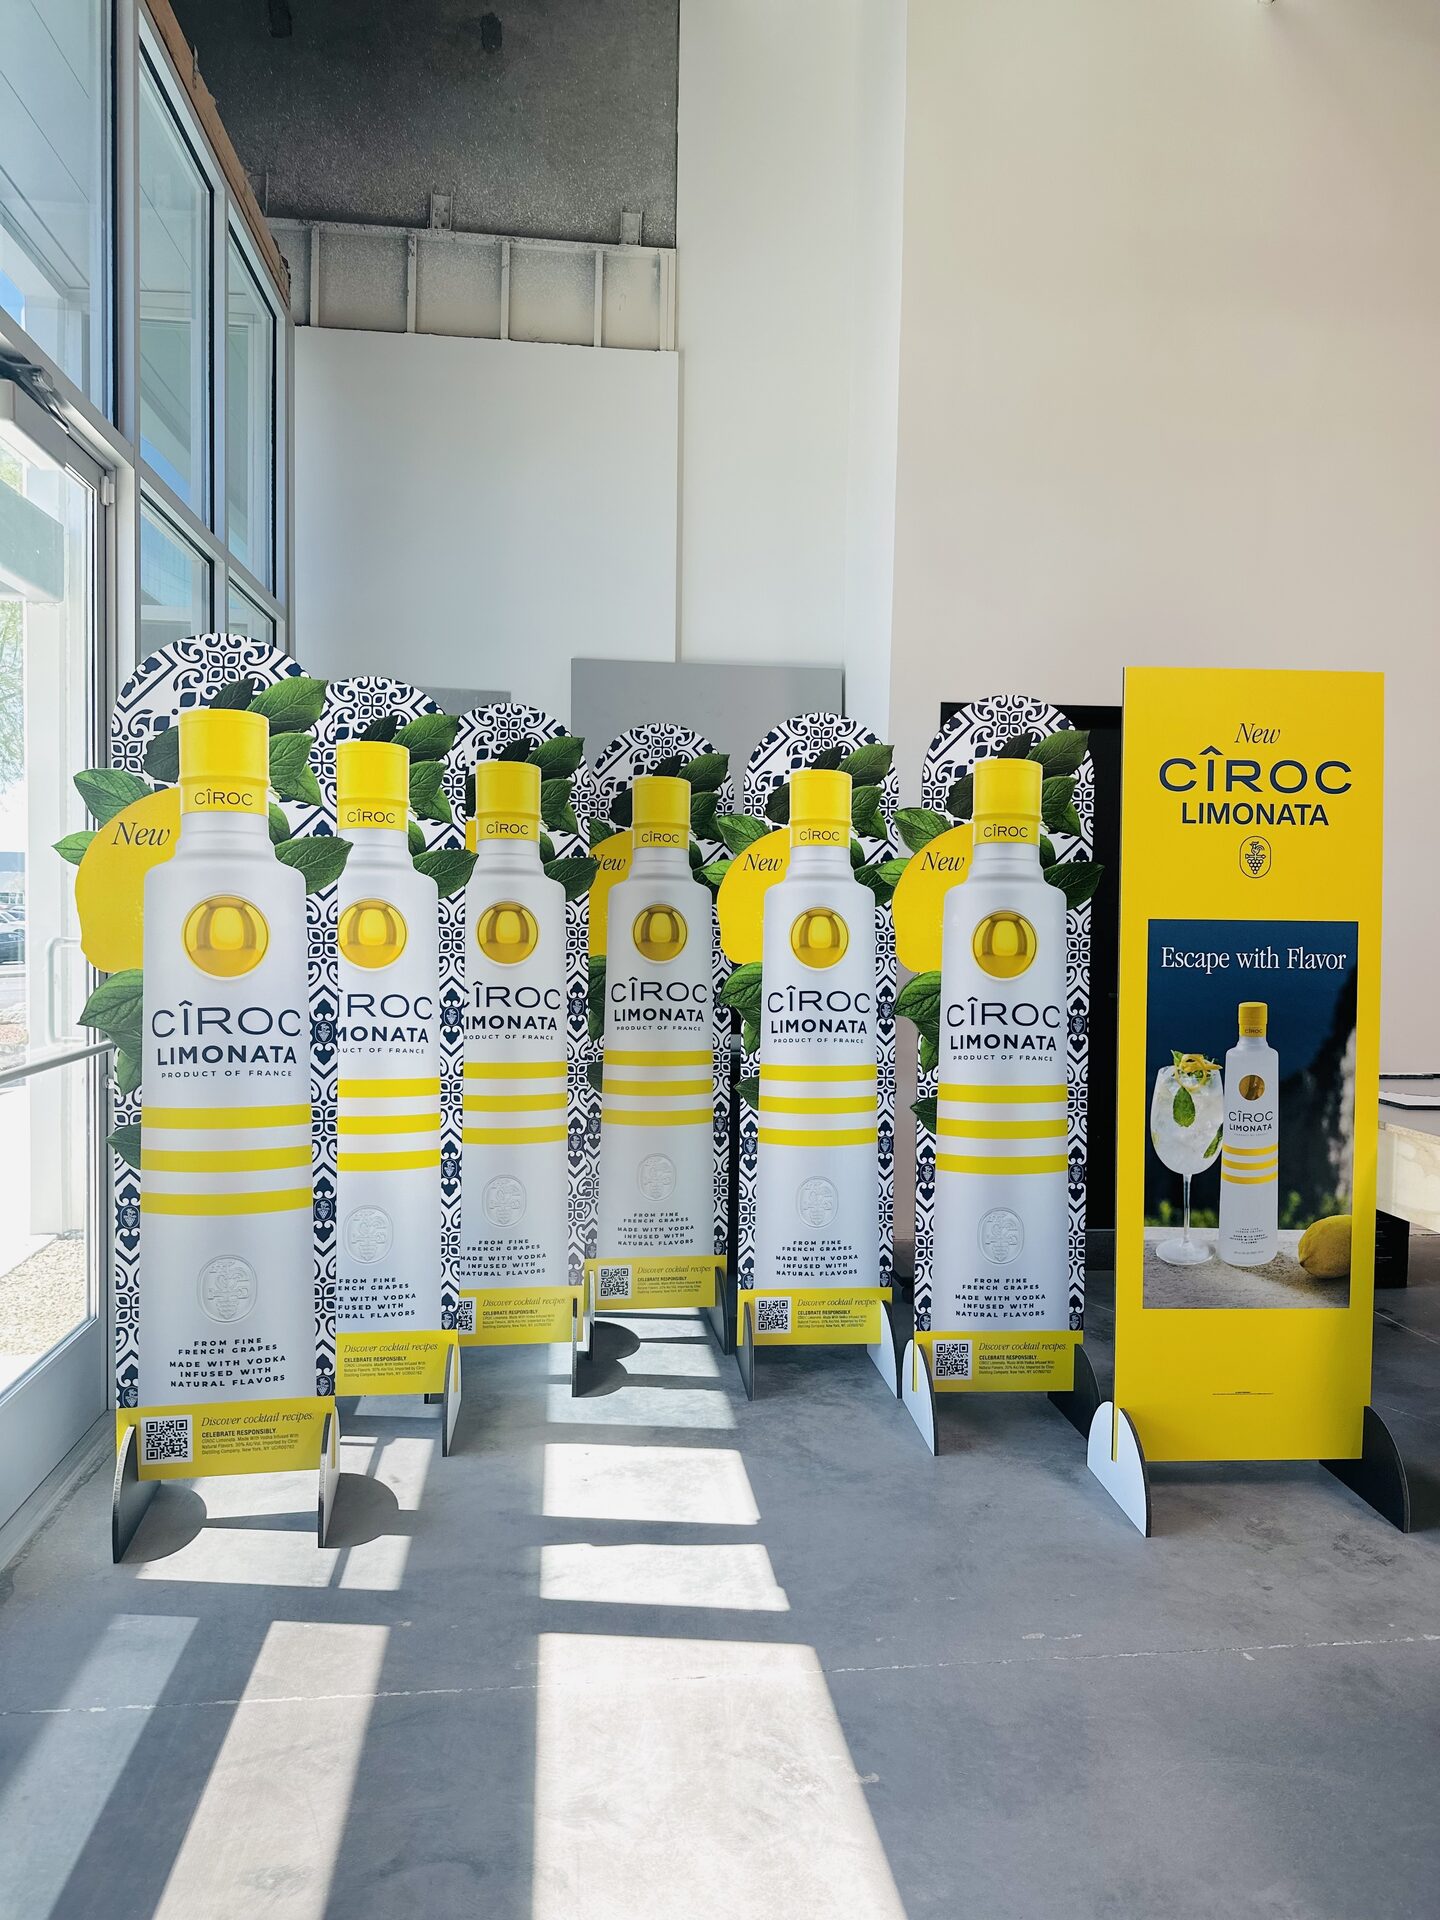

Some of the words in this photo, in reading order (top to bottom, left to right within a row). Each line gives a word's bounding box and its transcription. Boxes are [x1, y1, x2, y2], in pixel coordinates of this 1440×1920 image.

[1234, 723, 1281, 744] New
[1159, 745, 1352, 794] CÎROC
[194, 789, 253, 806] CÎROC
[347, 808, 395, 824] CÎROC
[1182, 802, 1329, 826] LIMONATA
[112, 822, 171, 846] New
[487, 821, 529, 835] CÎROC
[800, 829, 840, 841] CÎROC
[984, 824, 1028, 838] CÎROC
[641, 830, 680, 843] CÎROC
[743, 854, 783, 872] New
[920, 851, 965, 871] New
[1161, 946, 1230, 975] Escape
[1236, 946, 1280, 969] with
[1287, 946, 1347, 970] Flavor
[611, 976, 708, 1003] CÎROC
[338, 989, 433, 1020] ROC
[768, 985, 870, 1014] CÎROC
[152, 1000, 301, 1038] CÎROC
[614, 1008, 704, 1022] LIMONATA
[947, 997, 1060, 1028] CÎROC
[466, 1016, 557, 1030] IMONATA
[771, 1019, 867, 1034] LIMONATA
[338, 1026, 429, 1044] MONATA
[951, 1034, 1057, 1051] LIMONATA
[157, 1045, 297, 1066] LIMONATA
[161, 1071, 217, 1079] PRODUCT
[1229, 1110, 1273, 1122] CÎROC
[1229, 1124, 1272, 1132] LIMONATA
[506, 1268, 545, 1276] FLAVORS
[383, 1293, 416, 1301] VODKA
[483, 1299, 512, 1307] Discover
[514, 1297, 541, 1306] cocktail
[798, 1299, 826, 1307] Discover
[827, 1298, 854, 1306] cocktail
[371, 1310, 415, 1318] FLAVORS
[232, 1344, 277, 1353] GRAPES
[344, 1344, 378, 1353] Discover
[379, 1343, 411, 1352] cocktail
[979, 1343, 1010, 1351] Discover
[247, 1356, 286, 1365] VODKA
[180, 1370, 233, 1378] INFUSED
[240, 1367, 271, 1375] WITH
[232, 1375, 285, 1386] FLAVORS
[202, 1417, 242, 1427] Discover
[243, 1413, 280, 1424] cocktail
[202, 1430, 235, 1438] CELEBRATE
